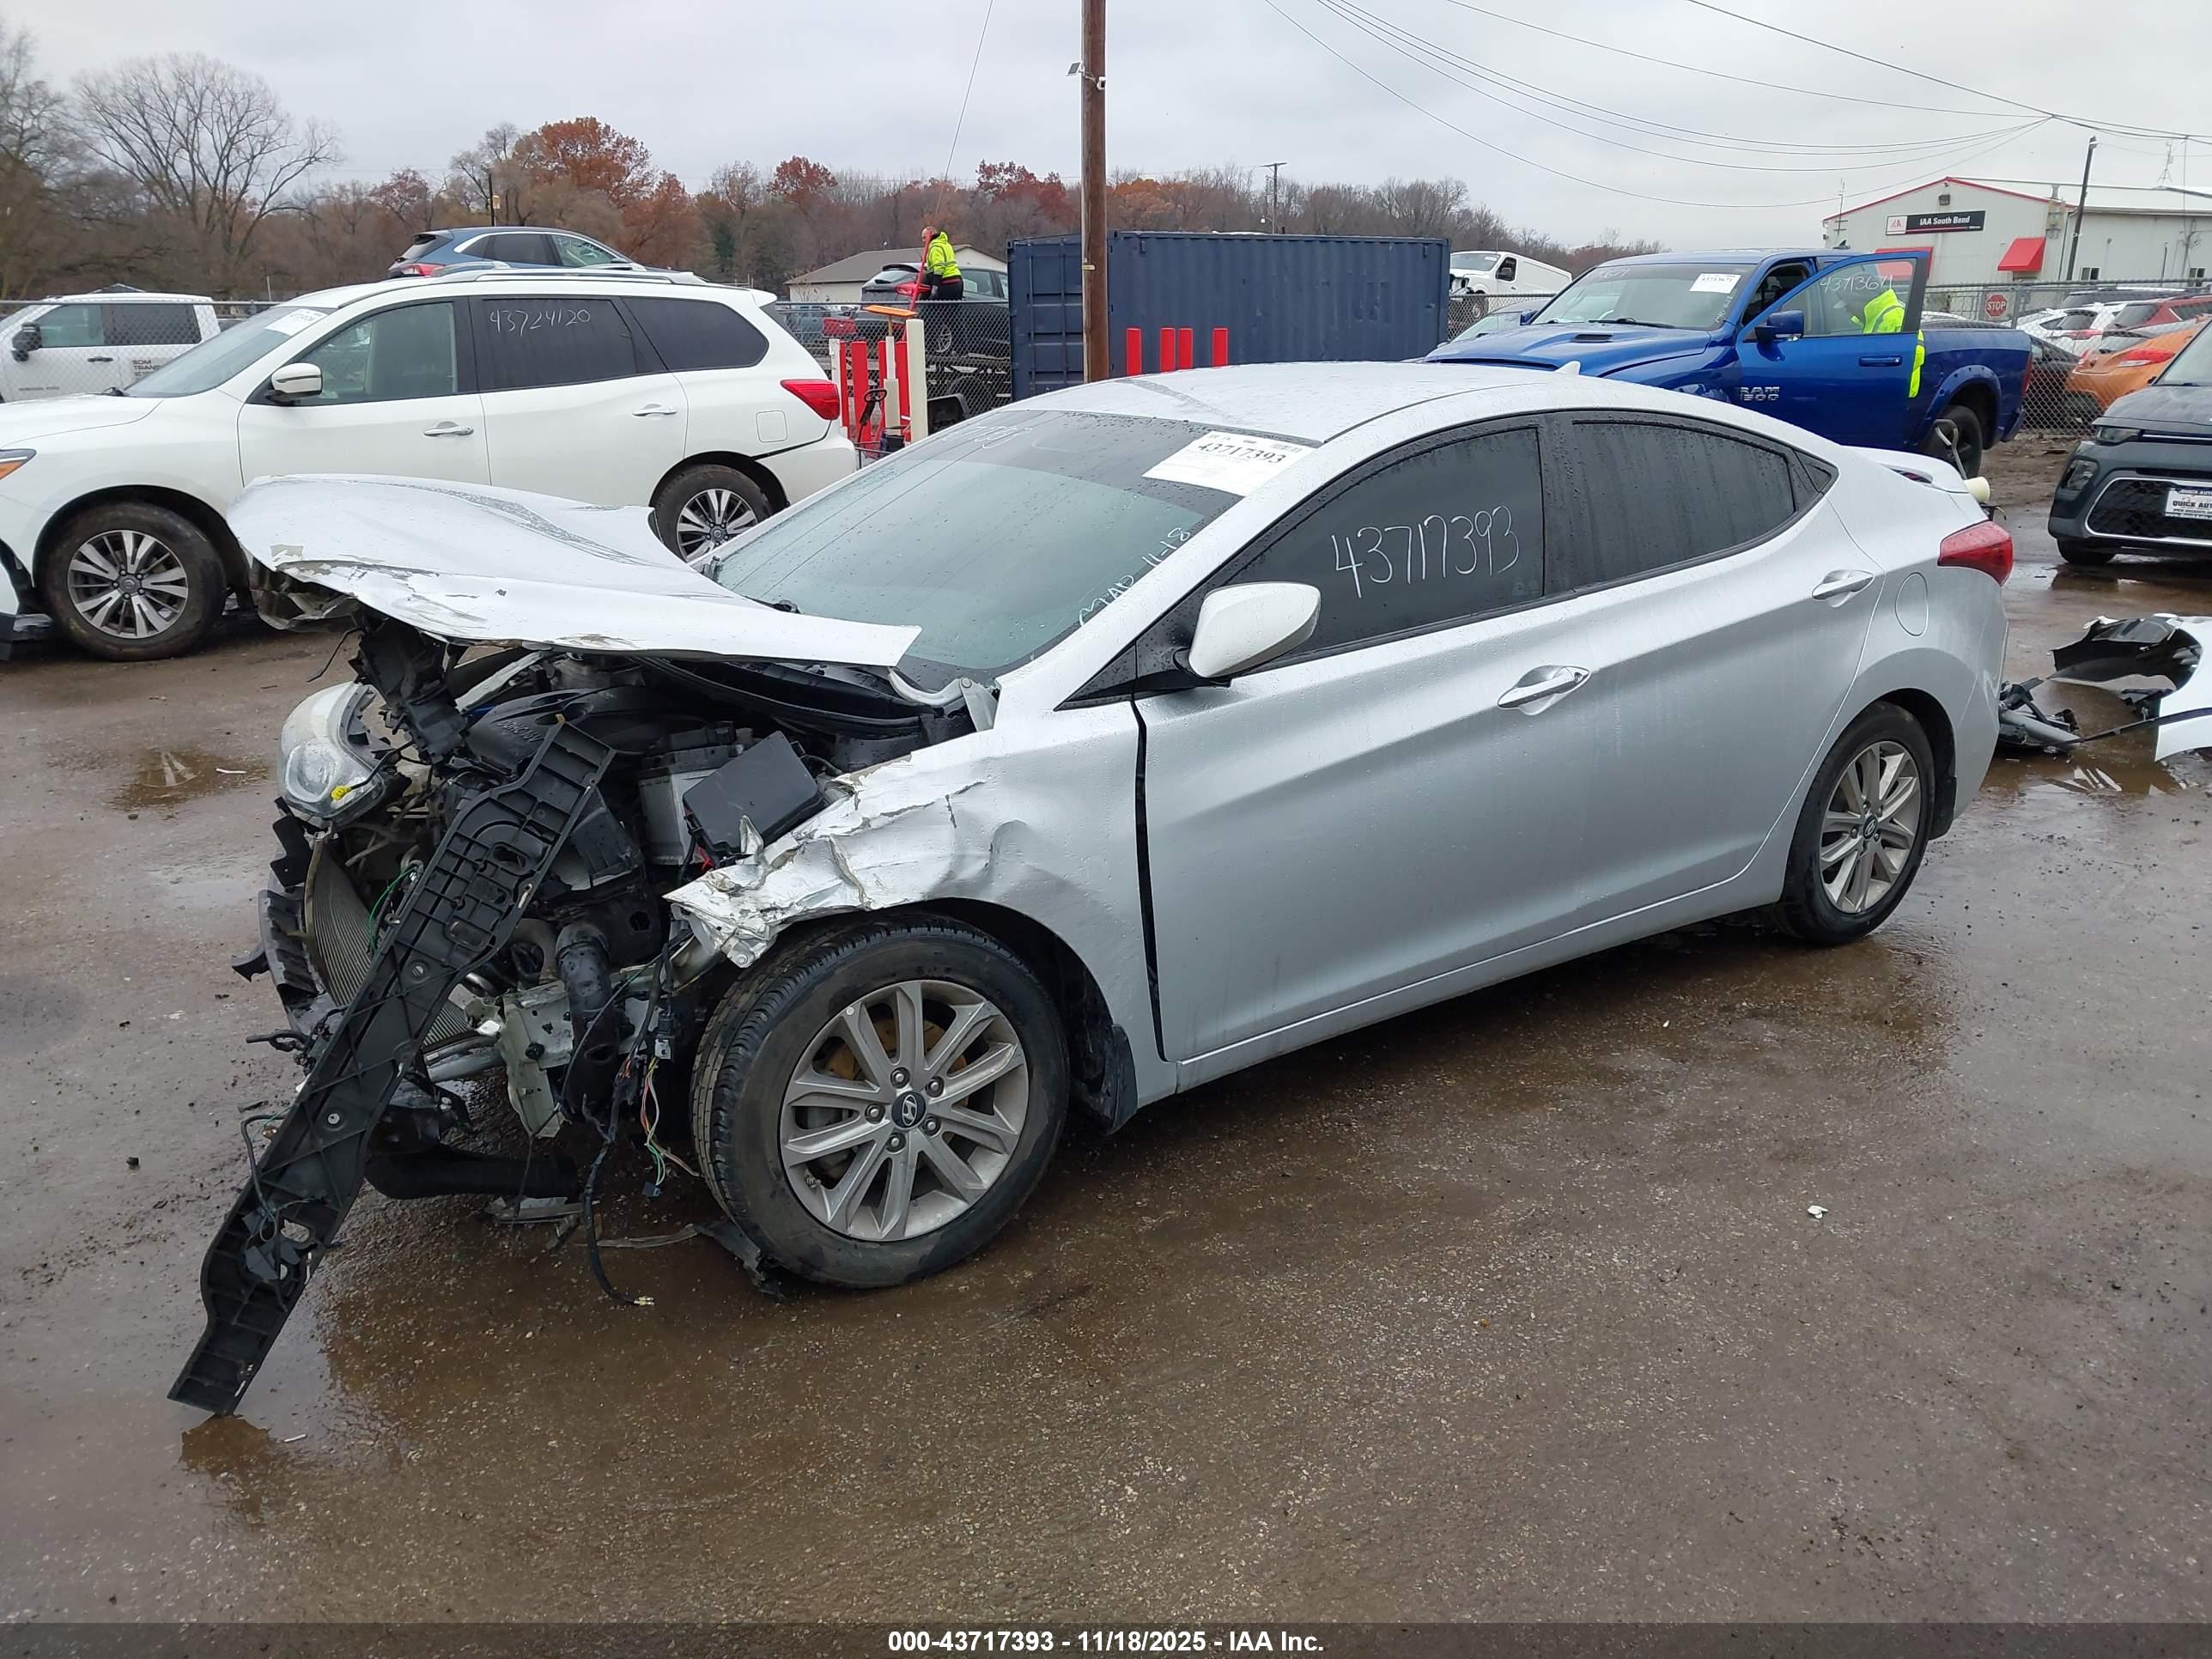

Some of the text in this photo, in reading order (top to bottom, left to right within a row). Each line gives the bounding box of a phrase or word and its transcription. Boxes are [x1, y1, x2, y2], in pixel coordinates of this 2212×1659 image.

[1933, 216, 1952, 225] South
[1953, 215, 1971, 224] Bend
[1986, 301, 2006, 311] STOP
[489, 308, 592, 337] 43724120
[1198, 441, 1287, 465] 43717393
[1332, 505, 1520, 599] 43717393
